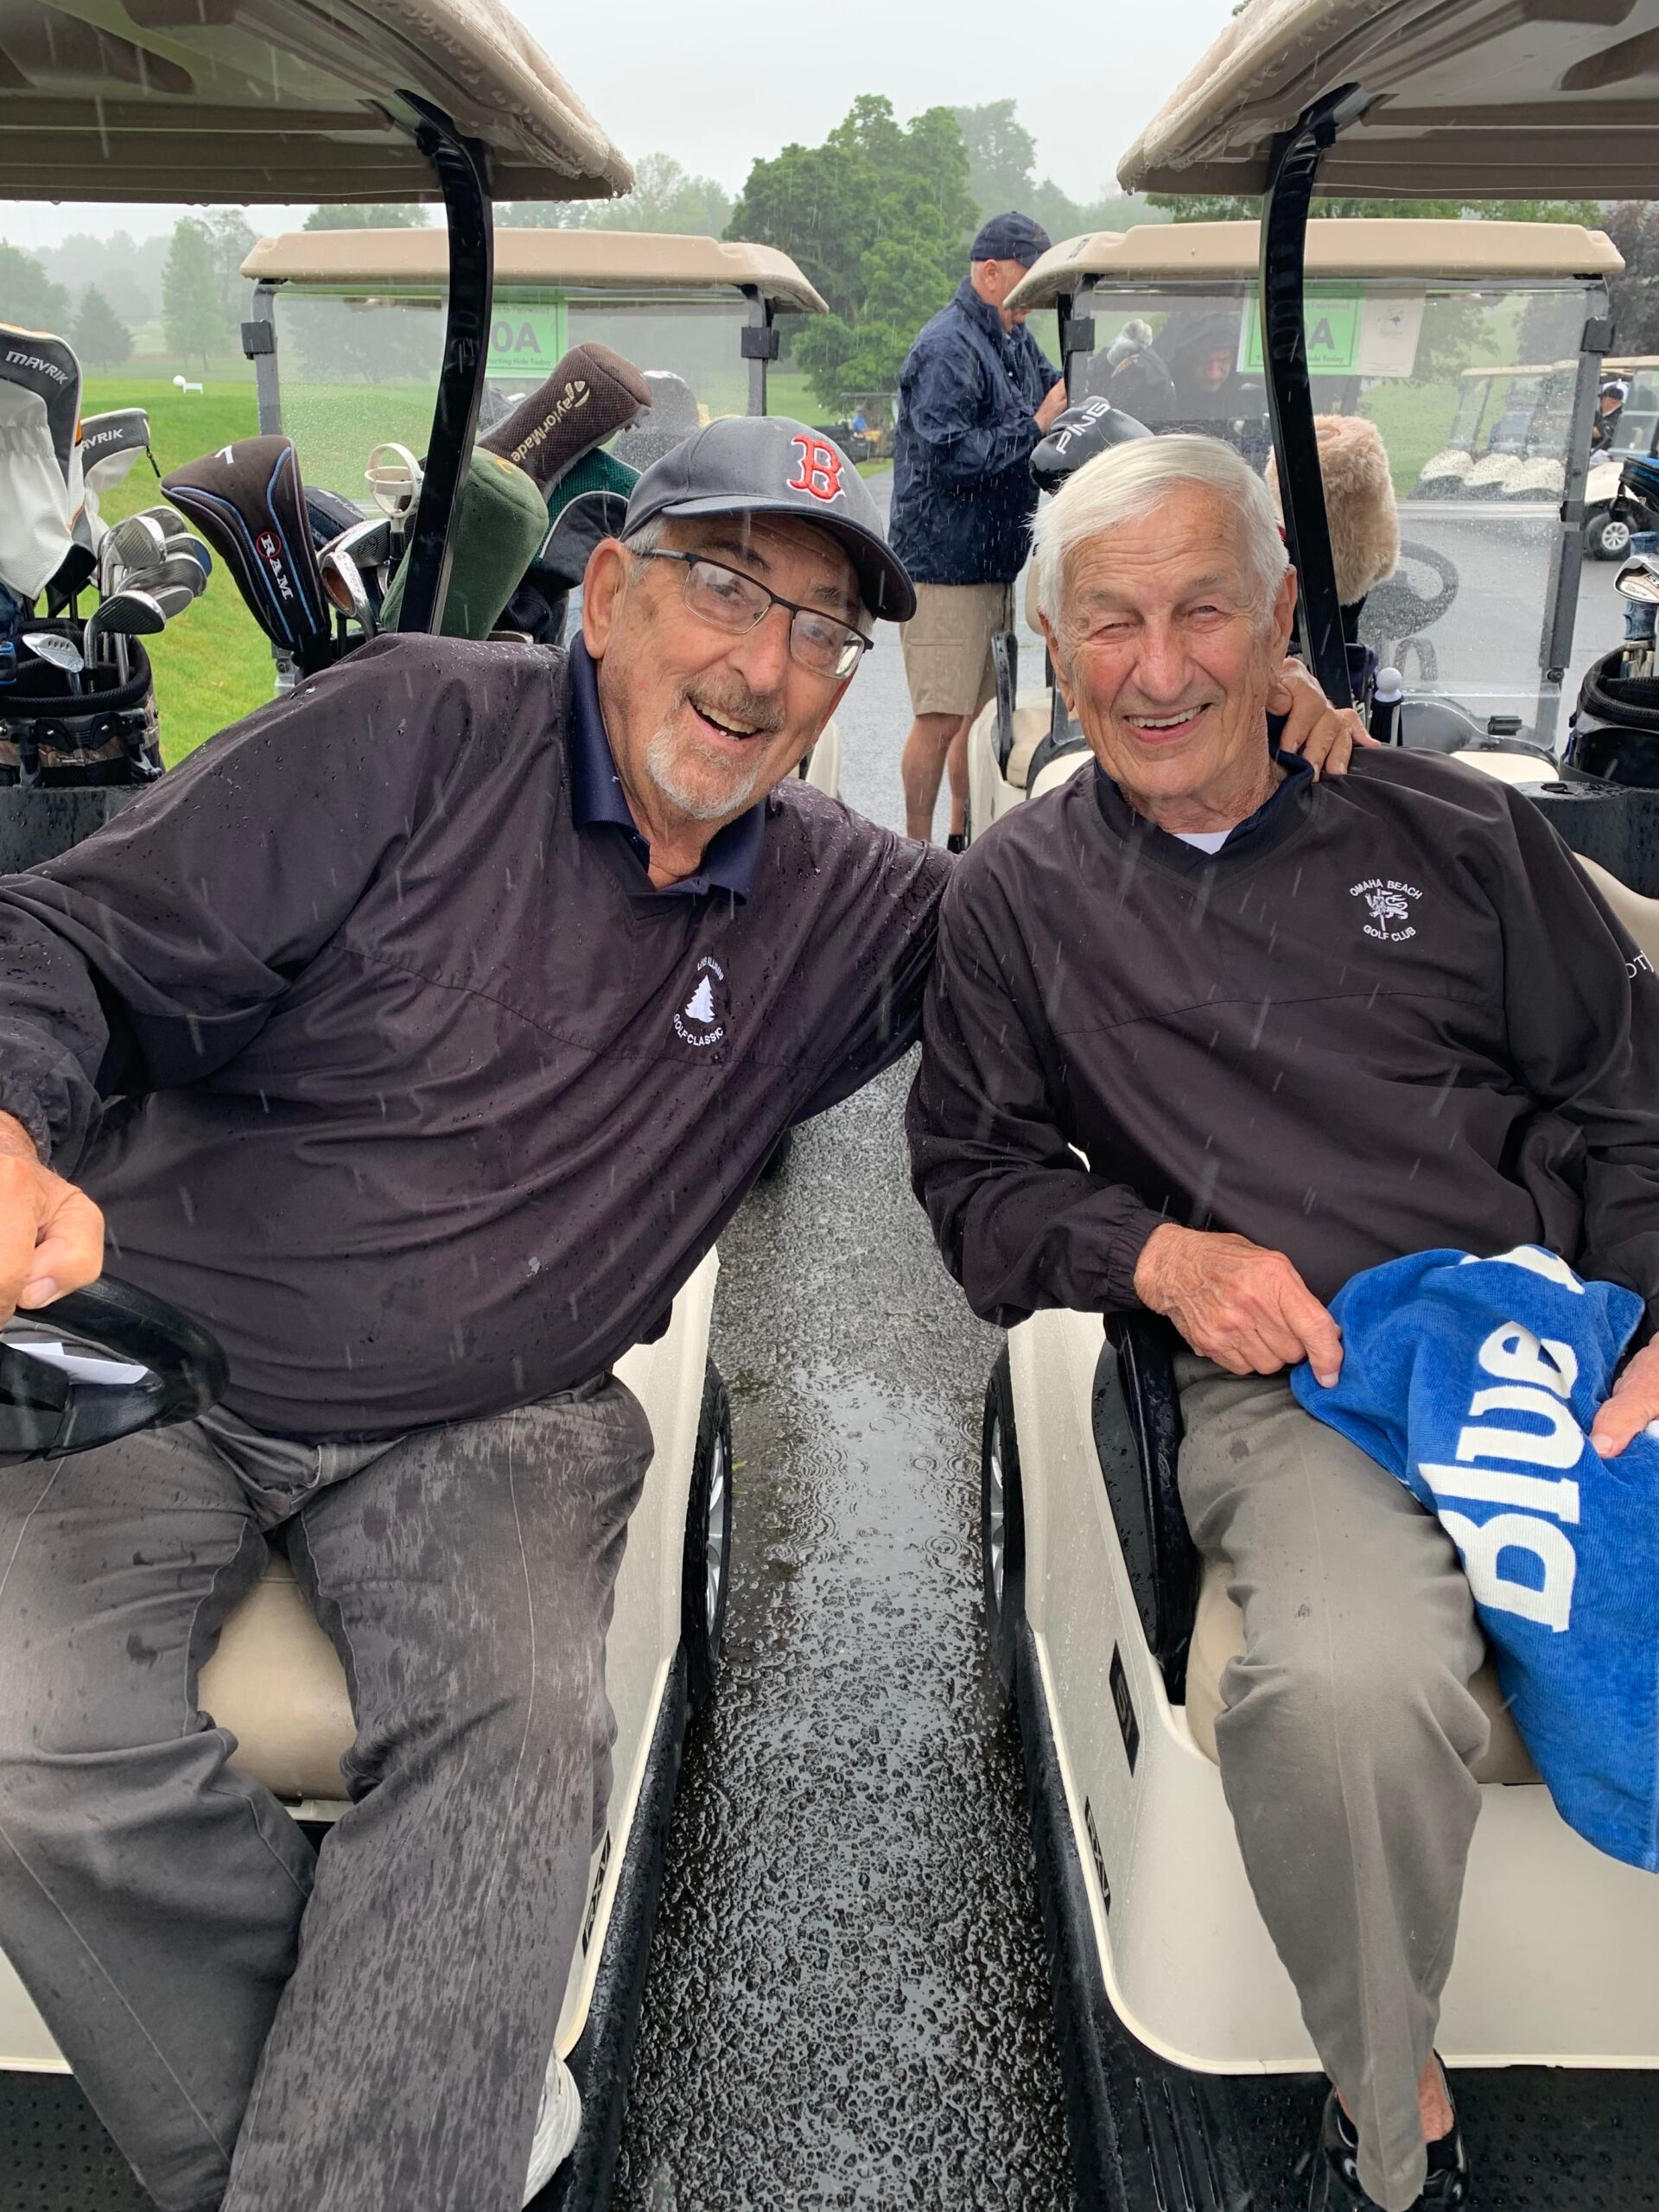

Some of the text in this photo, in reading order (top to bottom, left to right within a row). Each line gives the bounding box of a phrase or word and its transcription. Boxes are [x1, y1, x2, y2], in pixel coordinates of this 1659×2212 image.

[5, 351, 69, 385] MAVRIK
[530, 358, 552, 366] Today
[511, 380, 590, 462] TaylorMade
[1055, 401, 1112, 455] PING
[80, 428, 124, 451] AVRIK
[786, 432, 846, 503] B
[261, 533, 295, 601] RAM
[1350, 878, 1423, 899] OMAHA BEACH
[1363, 924, 1417, 942] GOLF CLUB
[673, 1013, 724, 1047] GOLF CLASSIC
[1418, 1319, 1585, 1633] Blue
